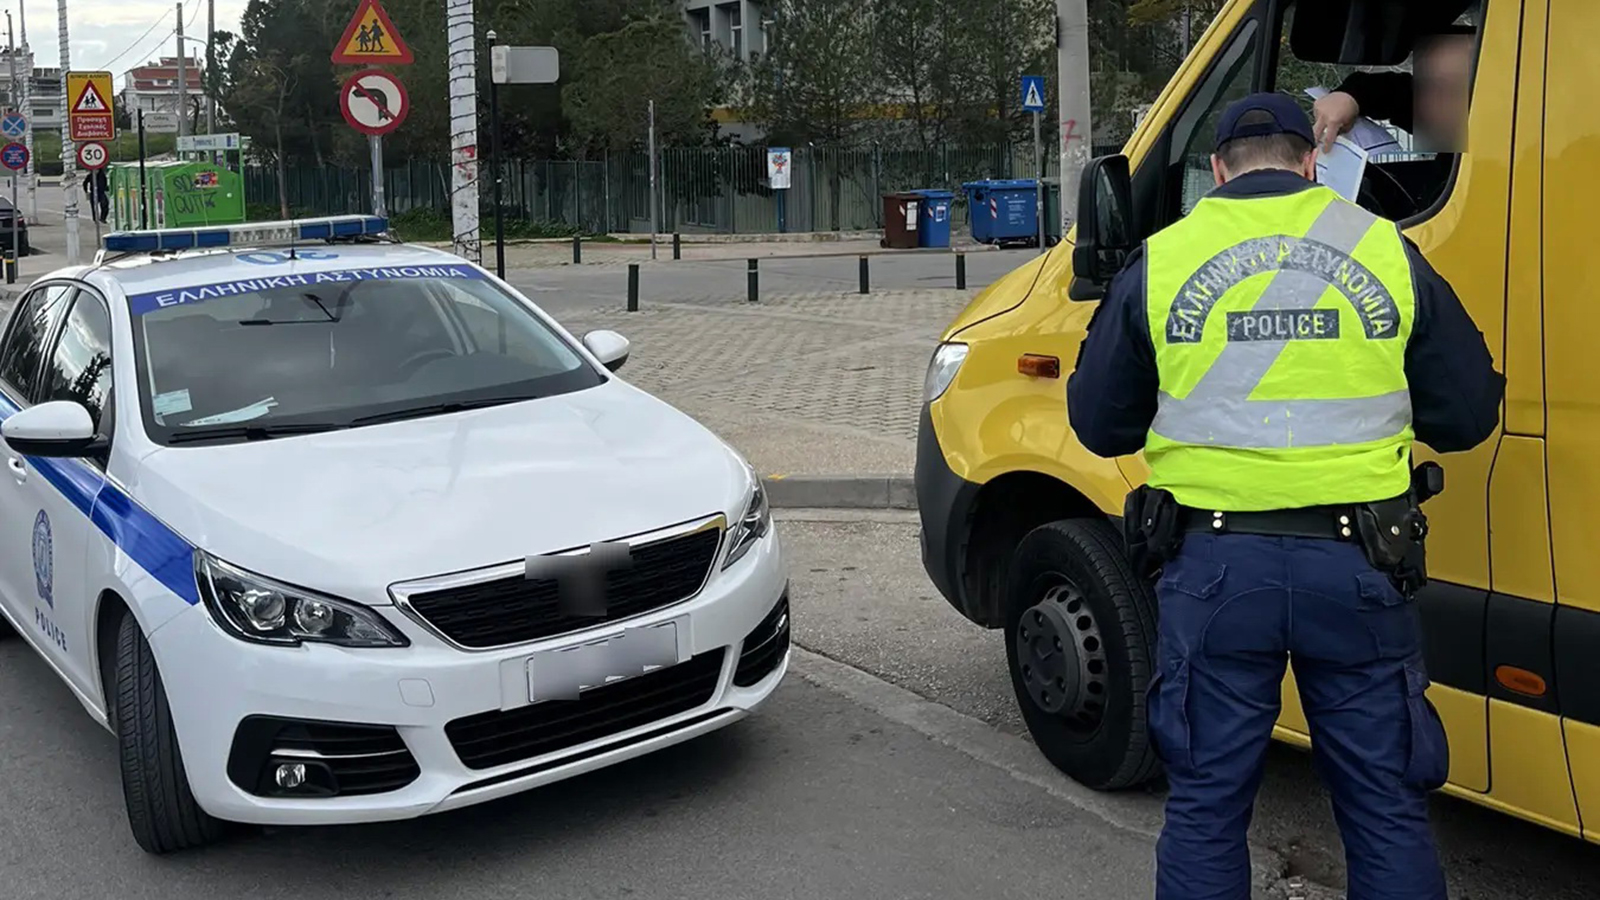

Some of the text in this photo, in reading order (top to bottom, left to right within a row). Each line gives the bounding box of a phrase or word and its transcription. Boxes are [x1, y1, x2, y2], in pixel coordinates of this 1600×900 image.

[84, 149, 102, 161] 30
[155, 267, 467, 308] ΕΛΛΗΝΙΚΗ ΑΣΤΥΝΟΜΙΑ
[1243, 313, 1325, 336] POLICE
[35, 606, 67, 652] POLICE
